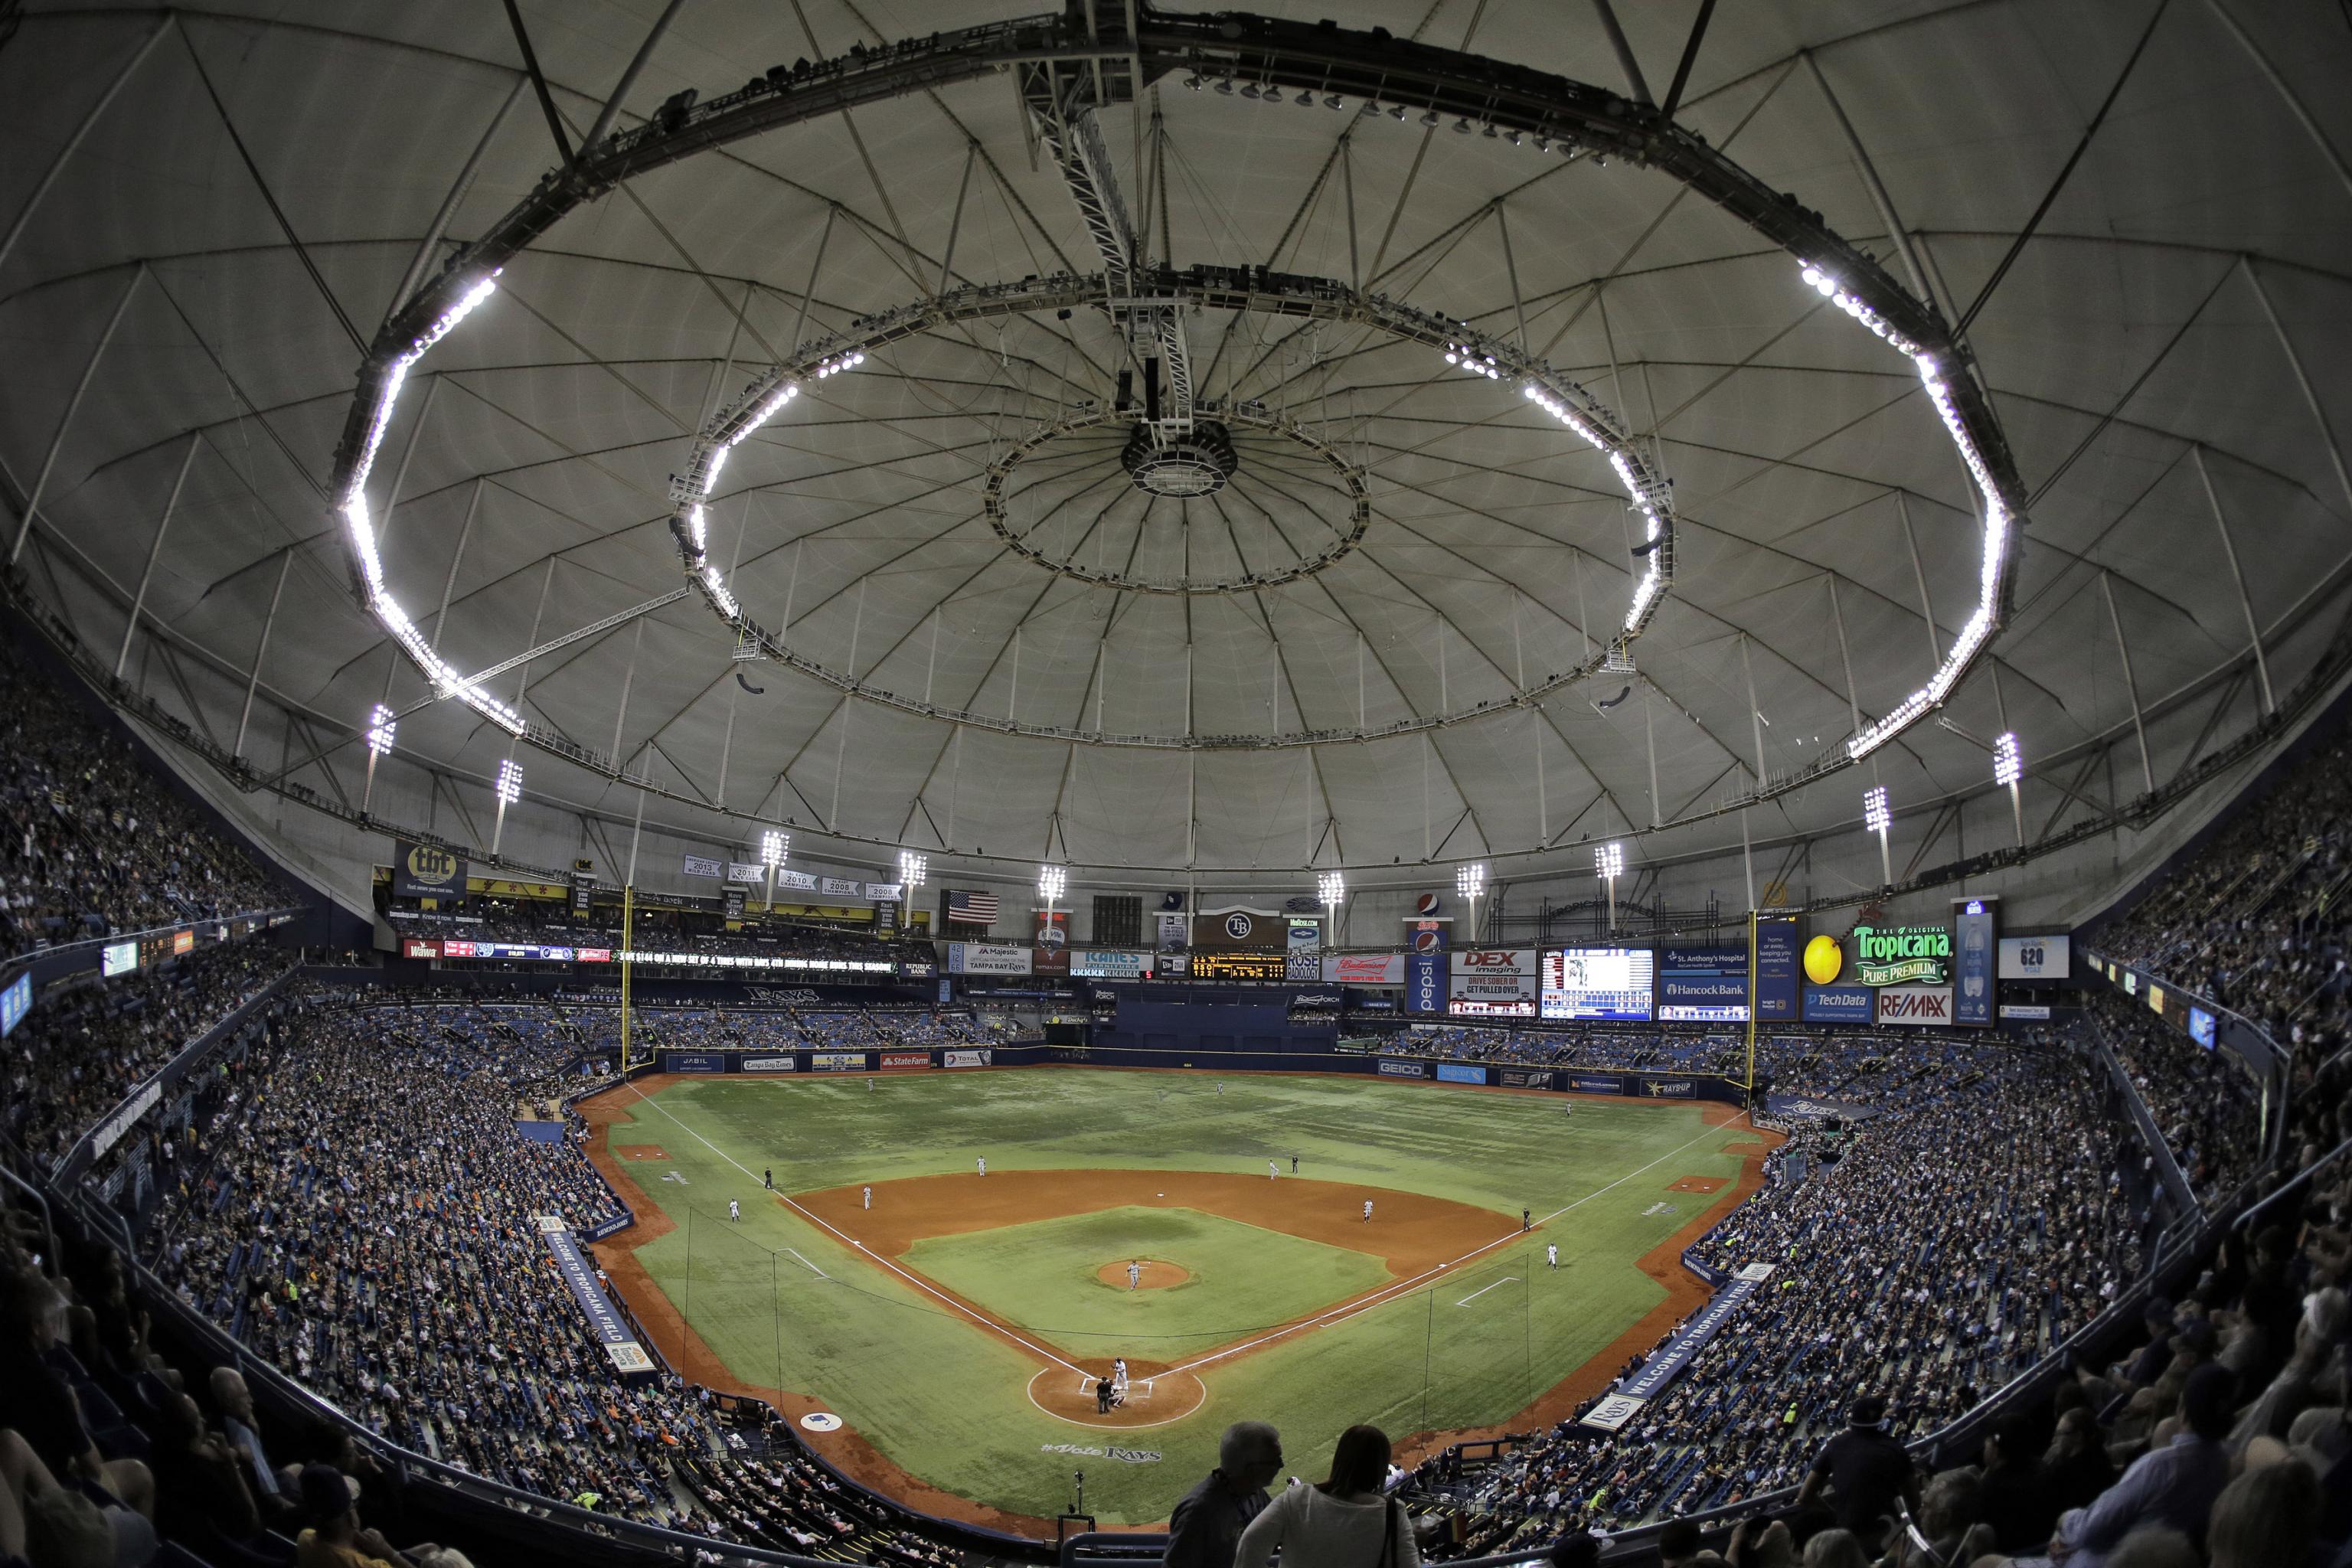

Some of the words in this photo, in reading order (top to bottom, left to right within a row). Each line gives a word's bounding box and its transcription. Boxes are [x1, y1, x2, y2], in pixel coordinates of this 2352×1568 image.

[416, 847, 450, 874] tbt
[694, 863, 712, 871] 2013
[780, 881, 812, 890] CHAMPIONS
[786, 876, 807, 884] 2010
[1230, 918, 1247, 934] TB
[1854, 926, 1949, 962] Tropicana
[410, 946, 437, 957] Wawa
[990, 948, 1018, 957] Majestic
[1687, 955, 1718, 963] Anthony's
[1719, 954, 1746, 963] Hospital
[2021, 948, 2043, 965] 620
[655, 952, 665, 962] ON
[665, 954, 671, 963] A
[672, 954, 687, 963] NEW
[688, 955, 699, 964] SET
[701, 956, 710, 964] OF
[710, 956, 717, 965] 4
[736, 957, 753, 966] WITH
[848, 962, 864, 971] THIS
[1288, 956, 1318, 967] ROSE
[1464, 952, 1517, 966] DEX
[1145, 970, 1152, 978] 5
[1287, 967, 1318, 979] RADIOLOGY
[1863, 969, 1888, 982] PURE
[1890, 963, 1936, 981] PREMIUM
[1419, 962, 1436, 1011] pepsi
[1468, 977, 1485, 985] DRIVE
[1487, 977, 1508, 985] SOBER
[1509, 977, 1517, 985] OR
[1467, 985, 1478, 994] GET
[1479, 985, 1503, 994] PULLED
[1678, 985, 1718, 995] Hancock
[1720, 985, 1743, 995] Bank
[1880, 994, 1947, 1018] RE/MAX
[1380, 1063, 1423, 1075] GEICO
[551, 1233, 576, 1261] WELCOME
[568, 1263, 580, 1272] TO
[573, 1271, 607, 1315] TROPICANA
[599, 1316, 623, 1341] FIELD
[1628, 1352, 1683, 1395] WELCOME
[1677, 1340, 1694, 1354] TO
[1688, 1299, 1735, 1343] TROPICANA
[1728, 1280, 1753, 1299] FIELD
[1591, 1400, 1632, 1425] RAYS
[1041, 1444, 1103, 1455] #Vote
[1102, 1446, 1162, 1463] RAYS
